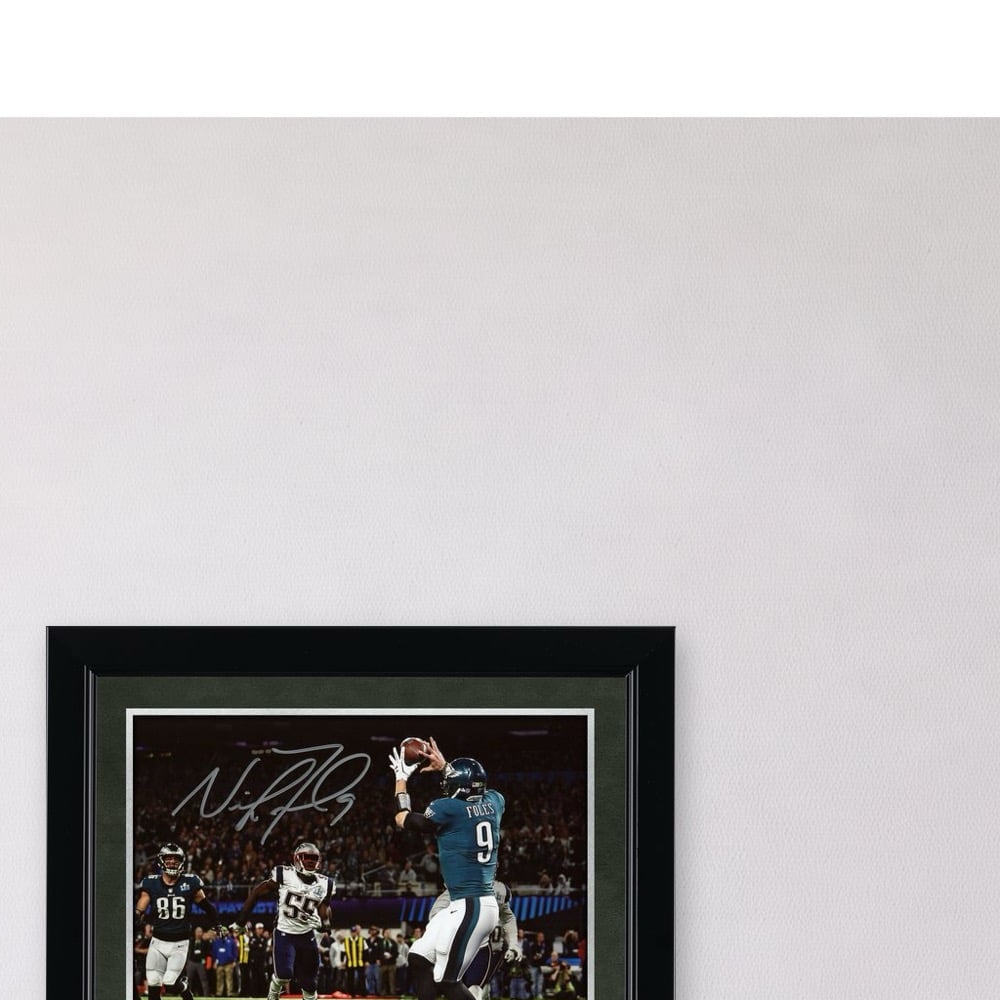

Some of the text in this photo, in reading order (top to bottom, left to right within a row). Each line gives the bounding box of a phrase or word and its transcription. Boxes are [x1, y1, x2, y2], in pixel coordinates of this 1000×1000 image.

[466, 802, 495, 818] FOLES
[476, 821, 493, 863] 9
[156, 896, 186, 920] 86
